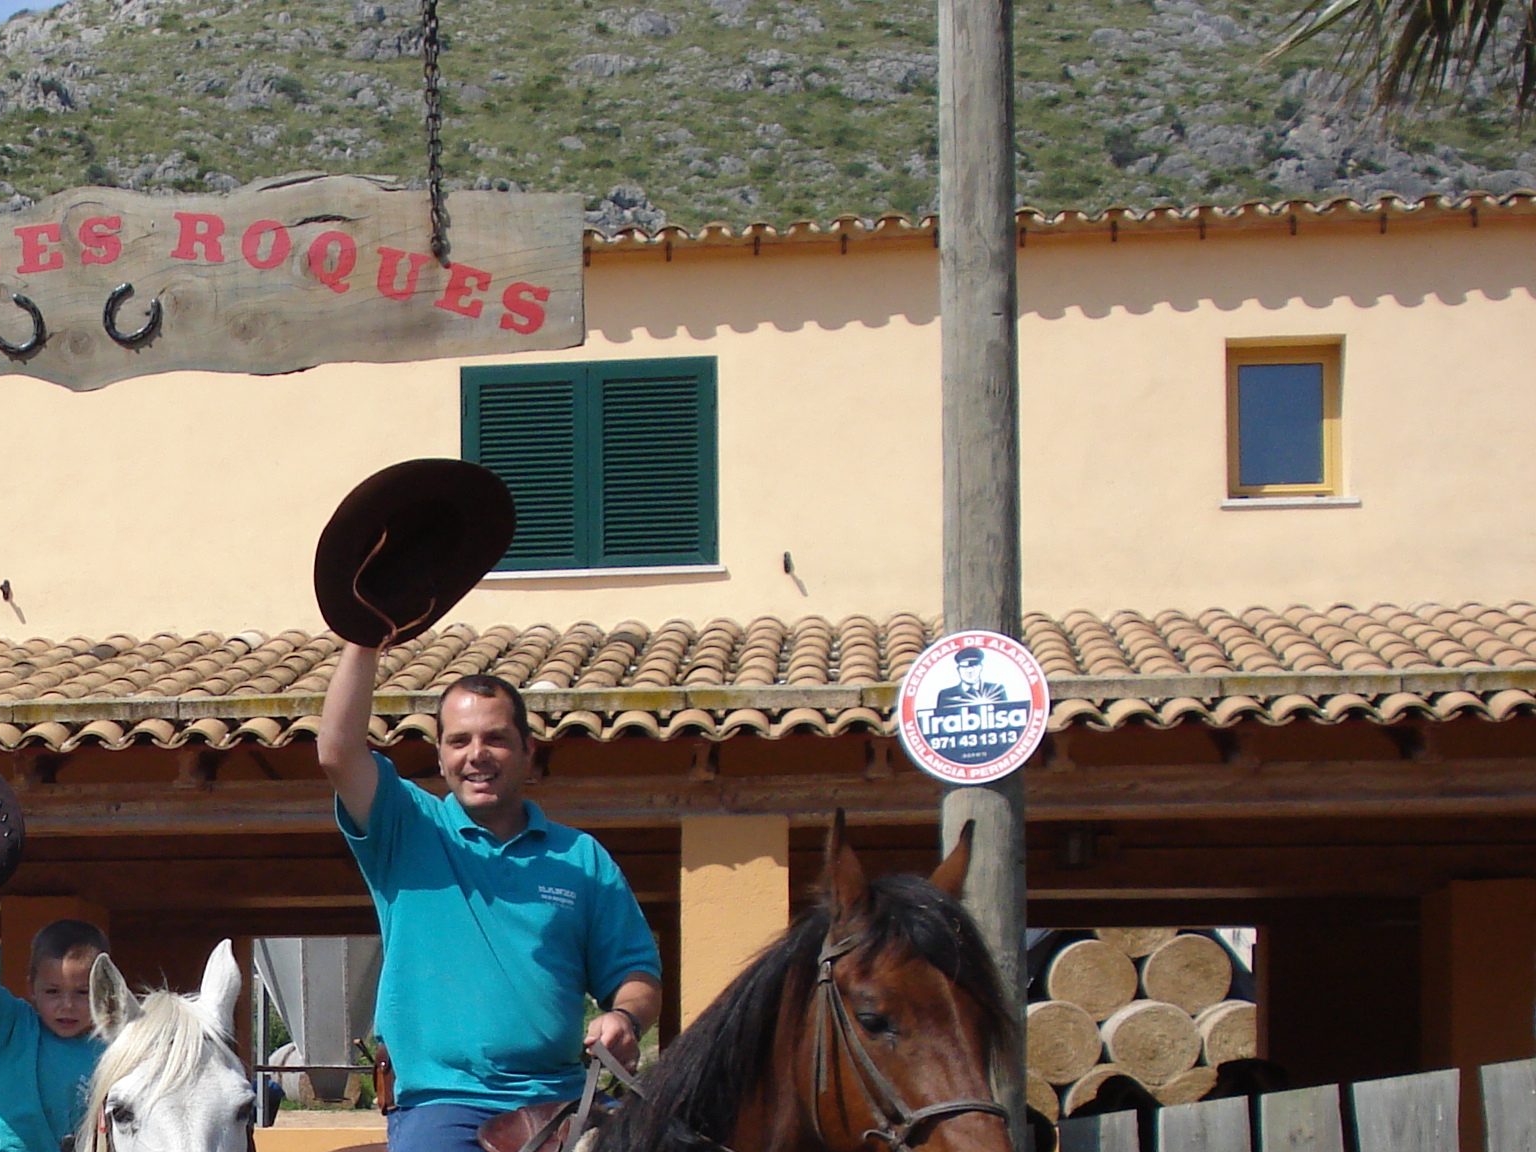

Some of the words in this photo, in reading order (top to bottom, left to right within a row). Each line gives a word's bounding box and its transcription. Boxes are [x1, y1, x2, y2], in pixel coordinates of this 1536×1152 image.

[170, 211, 552, 335] ROQUES
[906, 641, 961, 697] CENTRAL
[963, 636, 985, 647] DE
[988, 638, 1040, 685] ALARMA
[905, 720, 967, 778] VIGILANCIA
[969, 708, 1044, 778] PERMANENTE
[917, 704, 1027, 735] Trablisa
[930, 736, 956, 750] 971
[959, 734, 978, 747] 43
[980, 732, 998, 745] 13
[1000, 730, 1018, 743] 13
